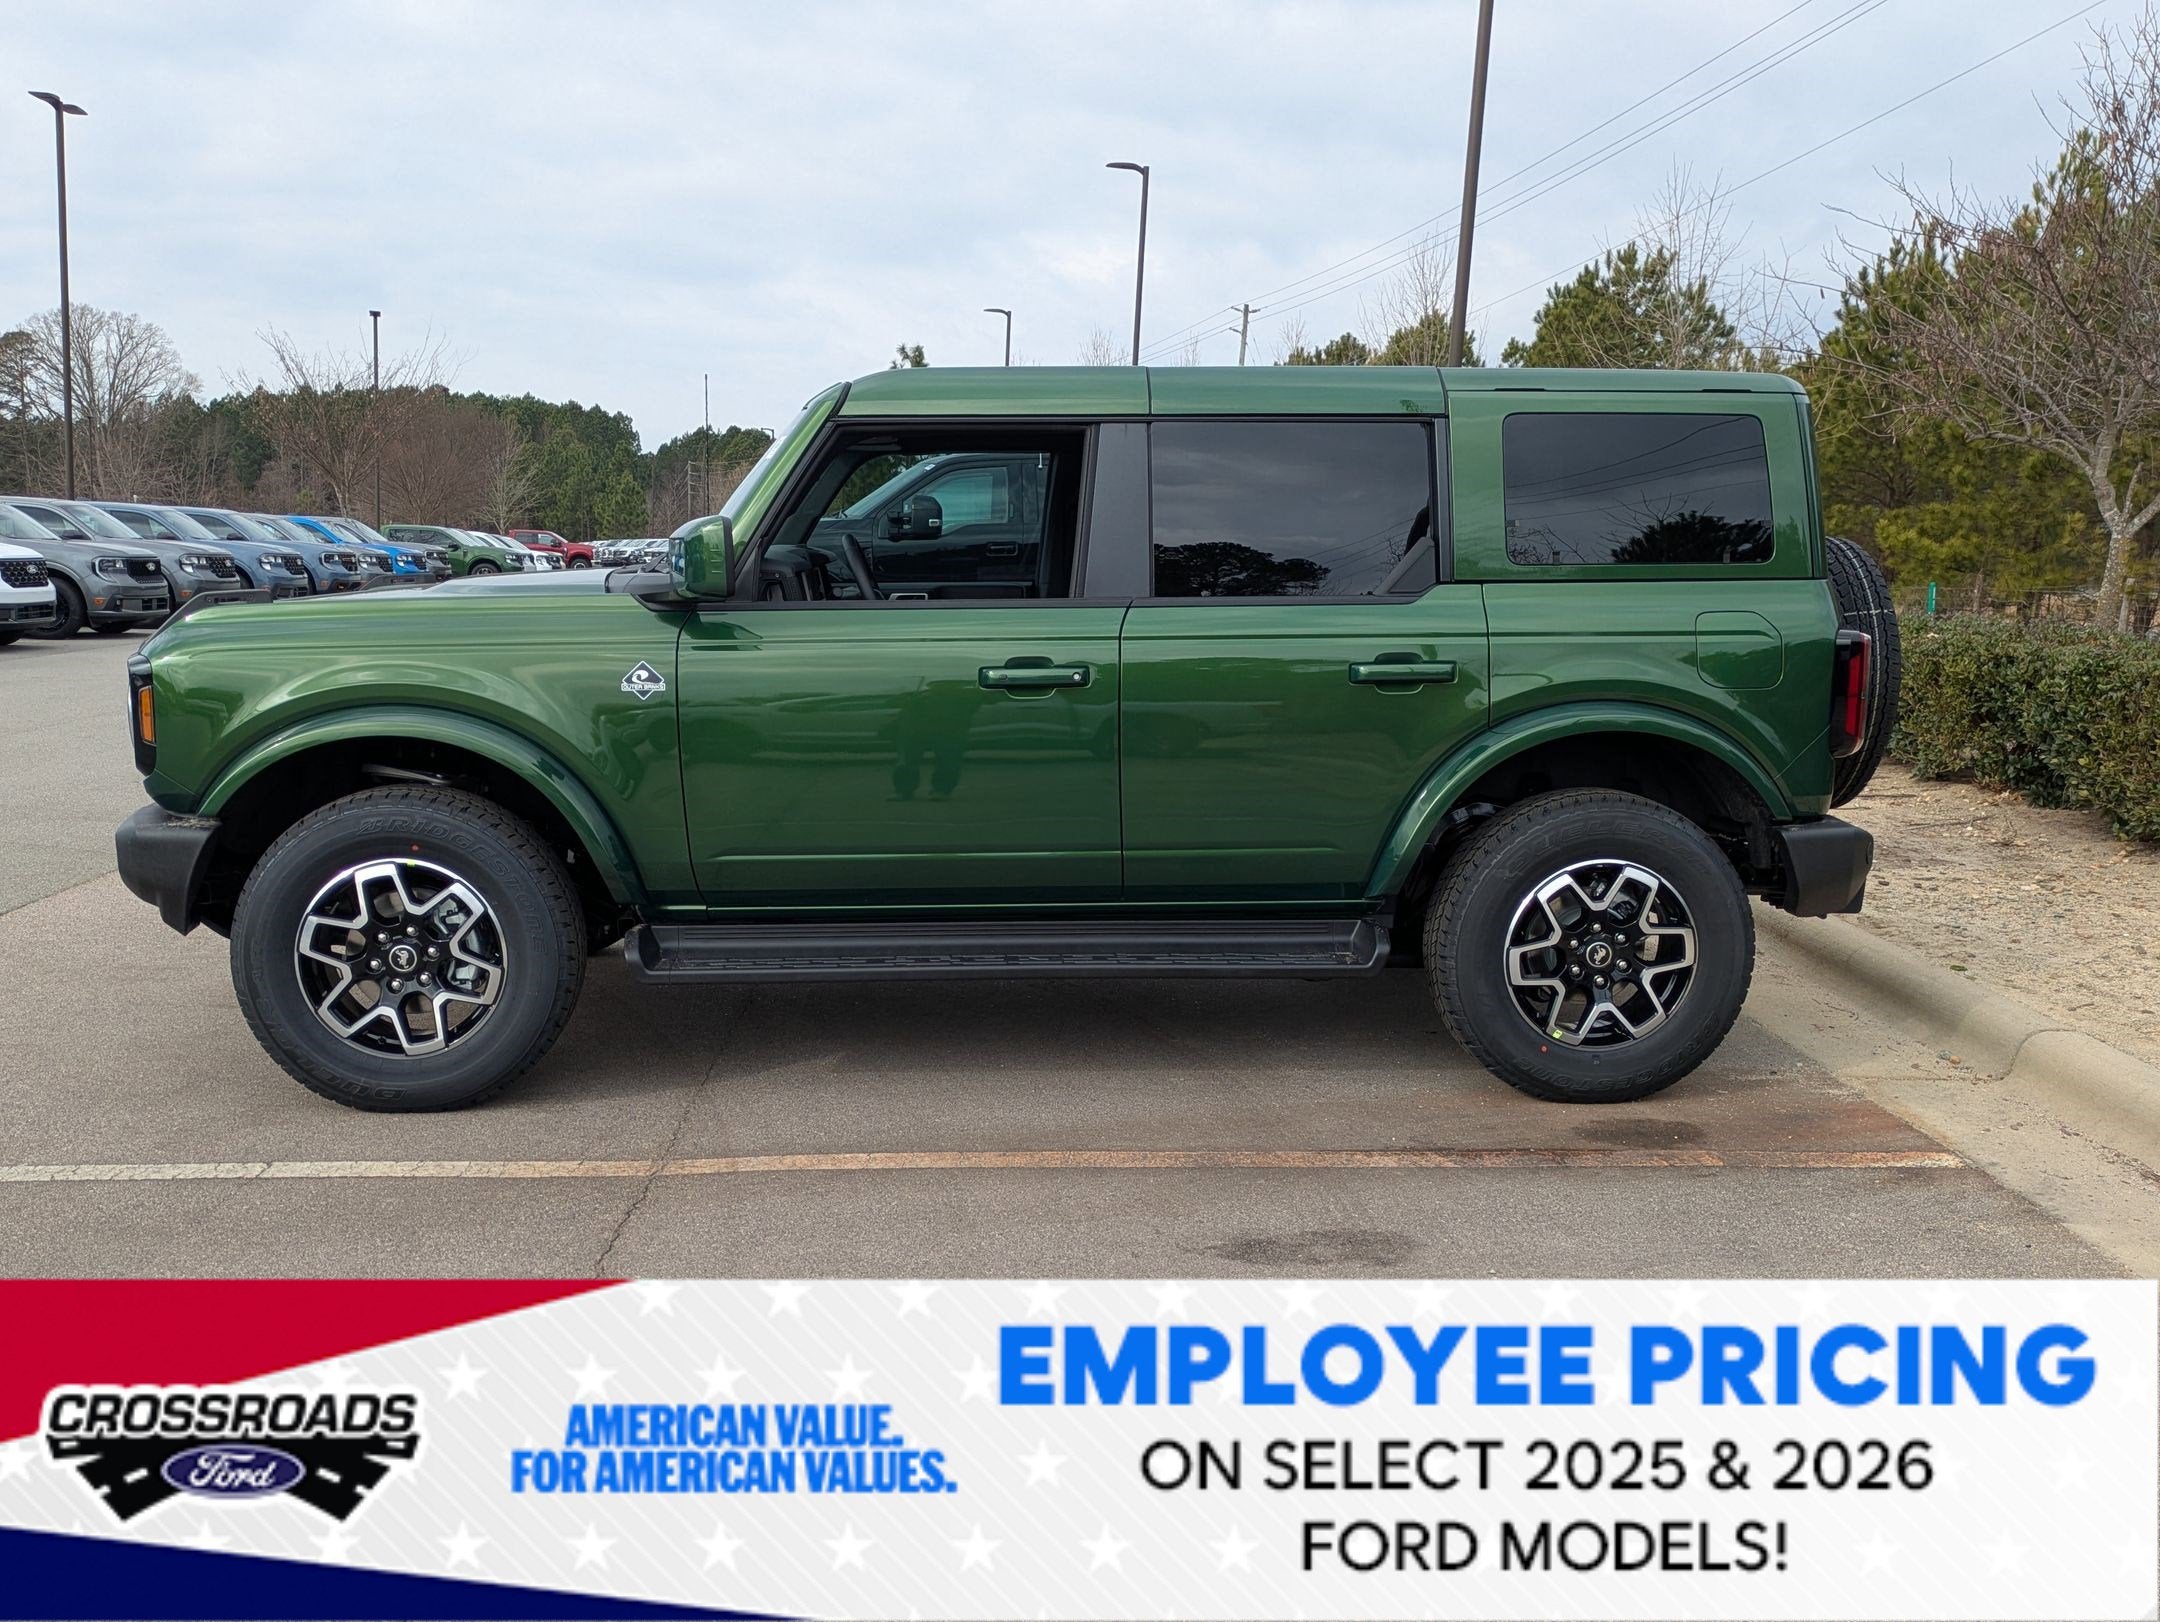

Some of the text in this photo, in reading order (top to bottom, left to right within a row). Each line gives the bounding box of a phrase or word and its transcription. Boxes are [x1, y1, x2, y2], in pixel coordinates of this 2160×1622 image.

[622, 683, 665, 691] OUTER BANKS
[356, 815, 549, 954] BRIDGESTONE
